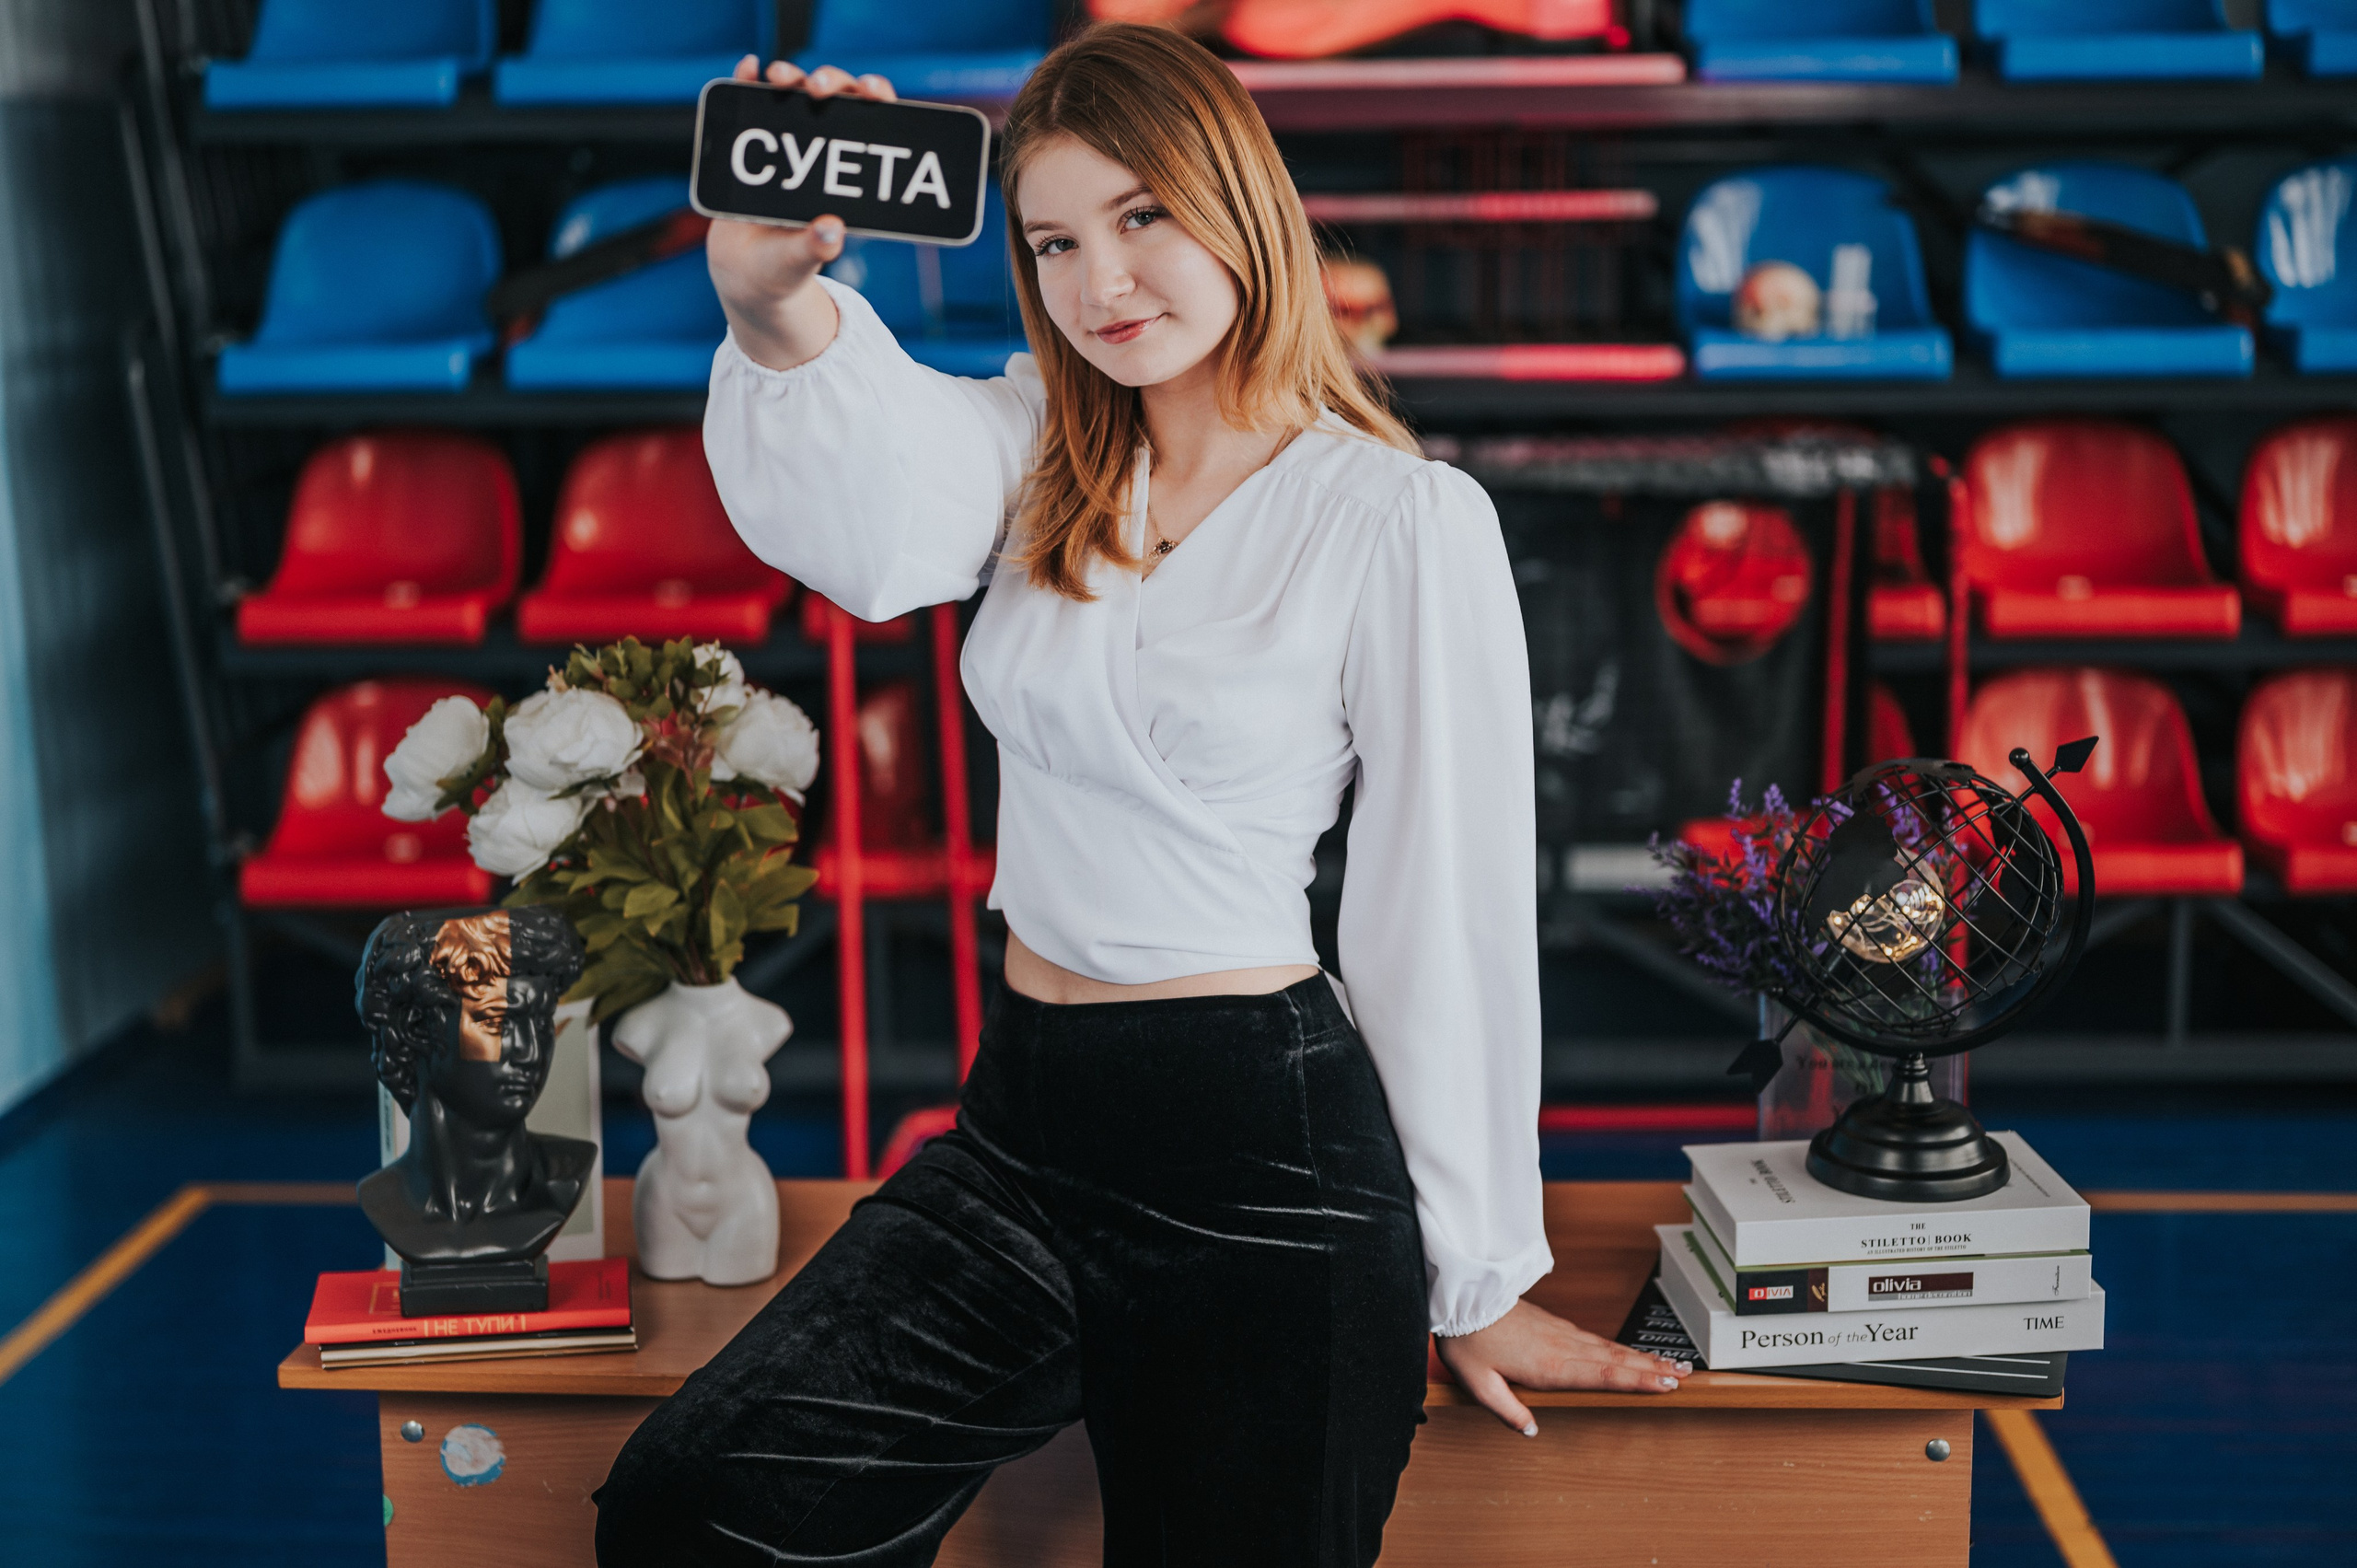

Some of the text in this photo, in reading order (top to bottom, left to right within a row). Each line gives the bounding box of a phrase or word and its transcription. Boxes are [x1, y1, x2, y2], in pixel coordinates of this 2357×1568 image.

[730, 127, 952, 210] СУЕТА
[1861, 1233, 1972, 1249] STILETTO BOOK
[1873, 1277, 1922, 1293] olivia
[434, 1318, 459, 1336] НЕ
[462, 1315, 515, 1335] ТУПИ
[2023, 1316, 2064, 1330] TIME
[1740, 1323, 1919, 1349] Person of the Year
